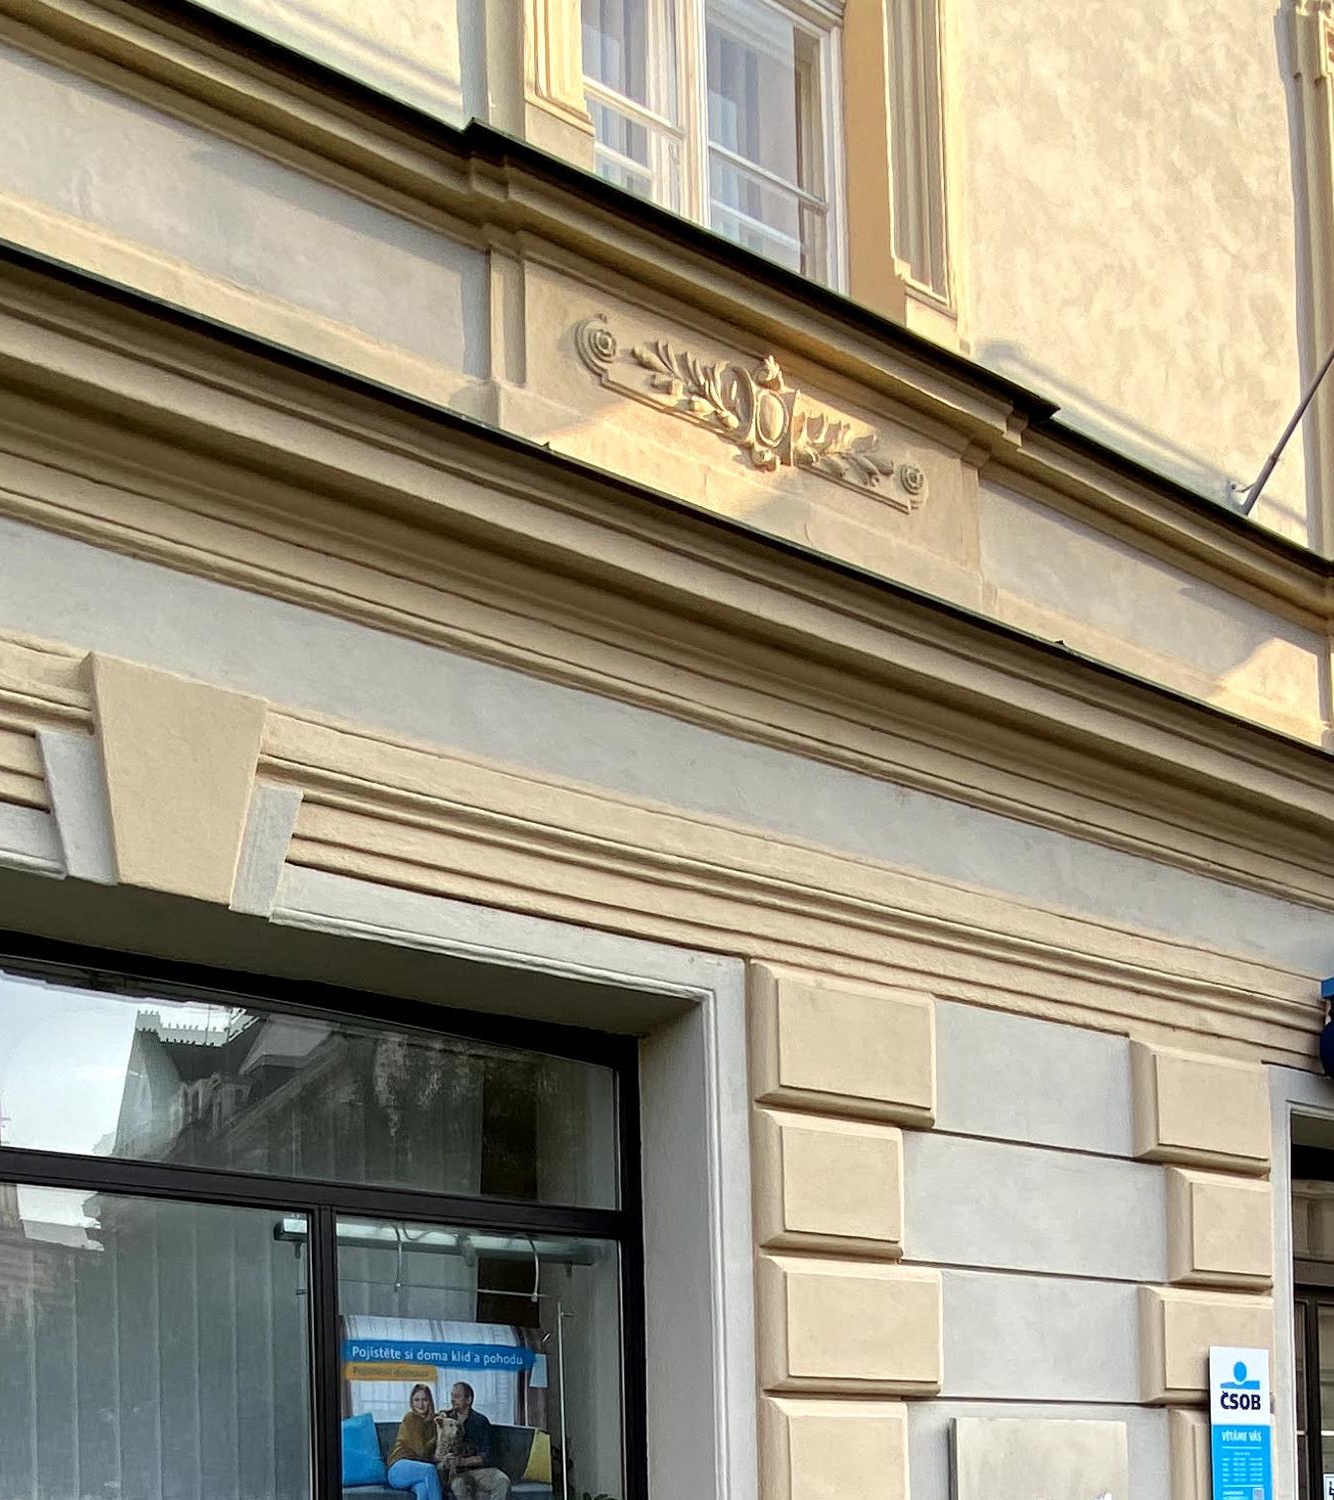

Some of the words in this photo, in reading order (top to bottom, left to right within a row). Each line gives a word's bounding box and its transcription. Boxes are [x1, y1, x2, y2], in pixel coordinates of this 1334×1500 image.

[352, 1346, 401, 1360] Pojistěte
[405, 1351, 414, 1360] si
[417, 1349, 448, 1362] doma
[451, 1350, 471, 1362] klid
[483, 1353, 523, 1366] pohodu
[1220, 1391, 1261, 1411] ČSOB
